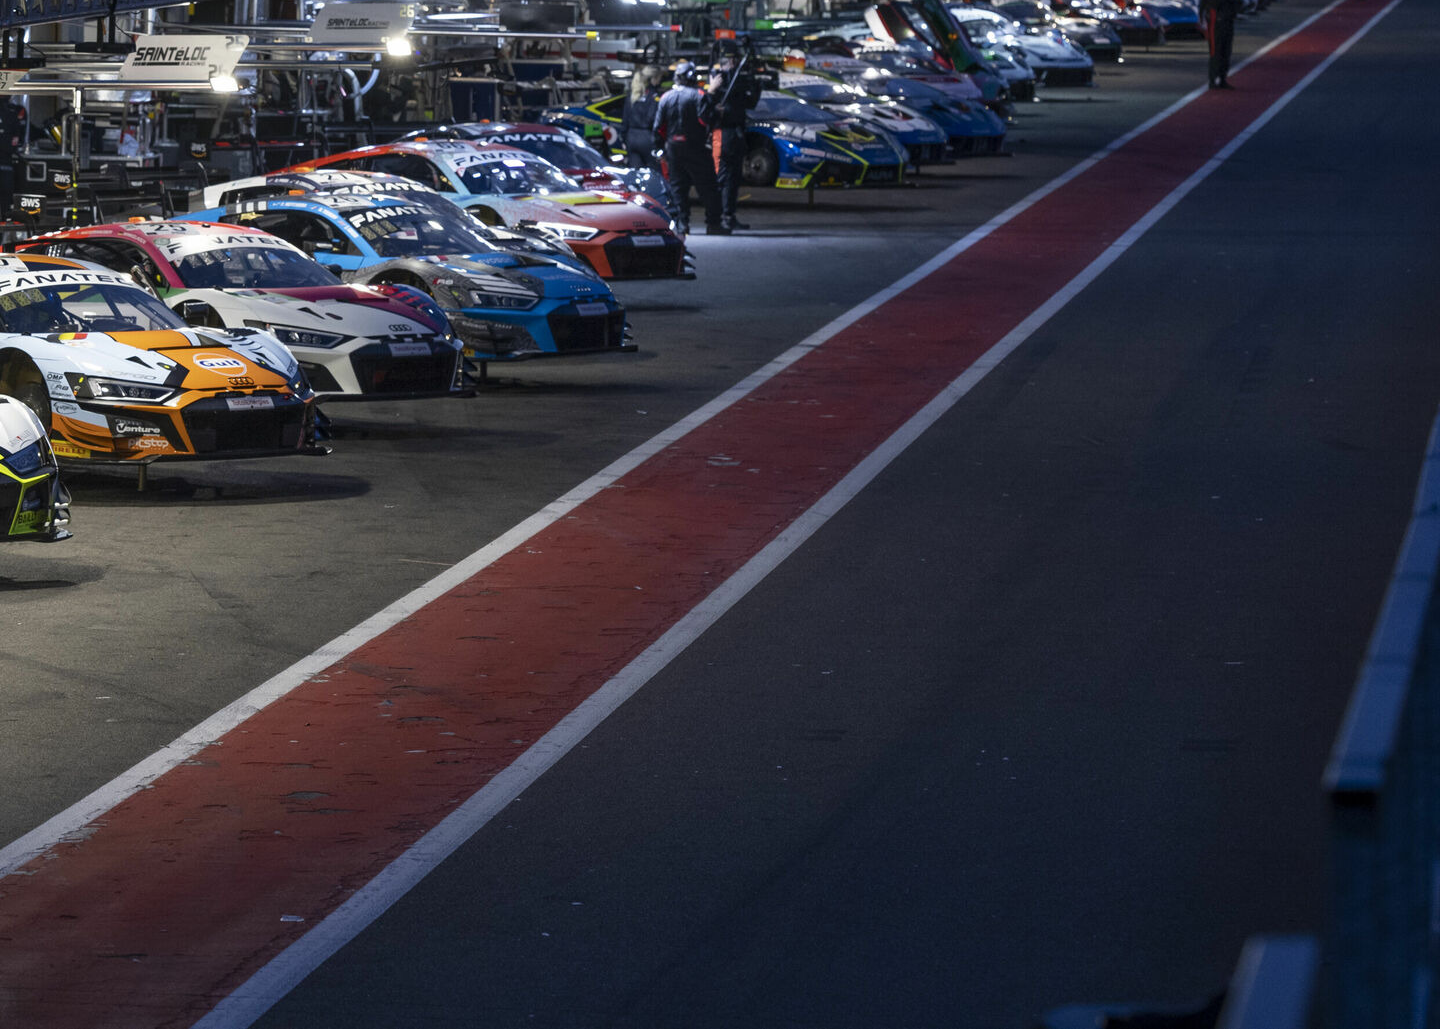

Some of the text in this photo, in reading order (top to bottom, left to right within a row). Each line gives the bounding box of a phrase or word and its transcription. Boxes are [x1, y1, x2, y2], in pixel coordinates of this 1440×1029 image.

[190, 142, 207, 153] aws
[54, 173, 71, 184] aws
[20, 196, 41, 209] aws
[199, 359, 241, 369] Gulf
